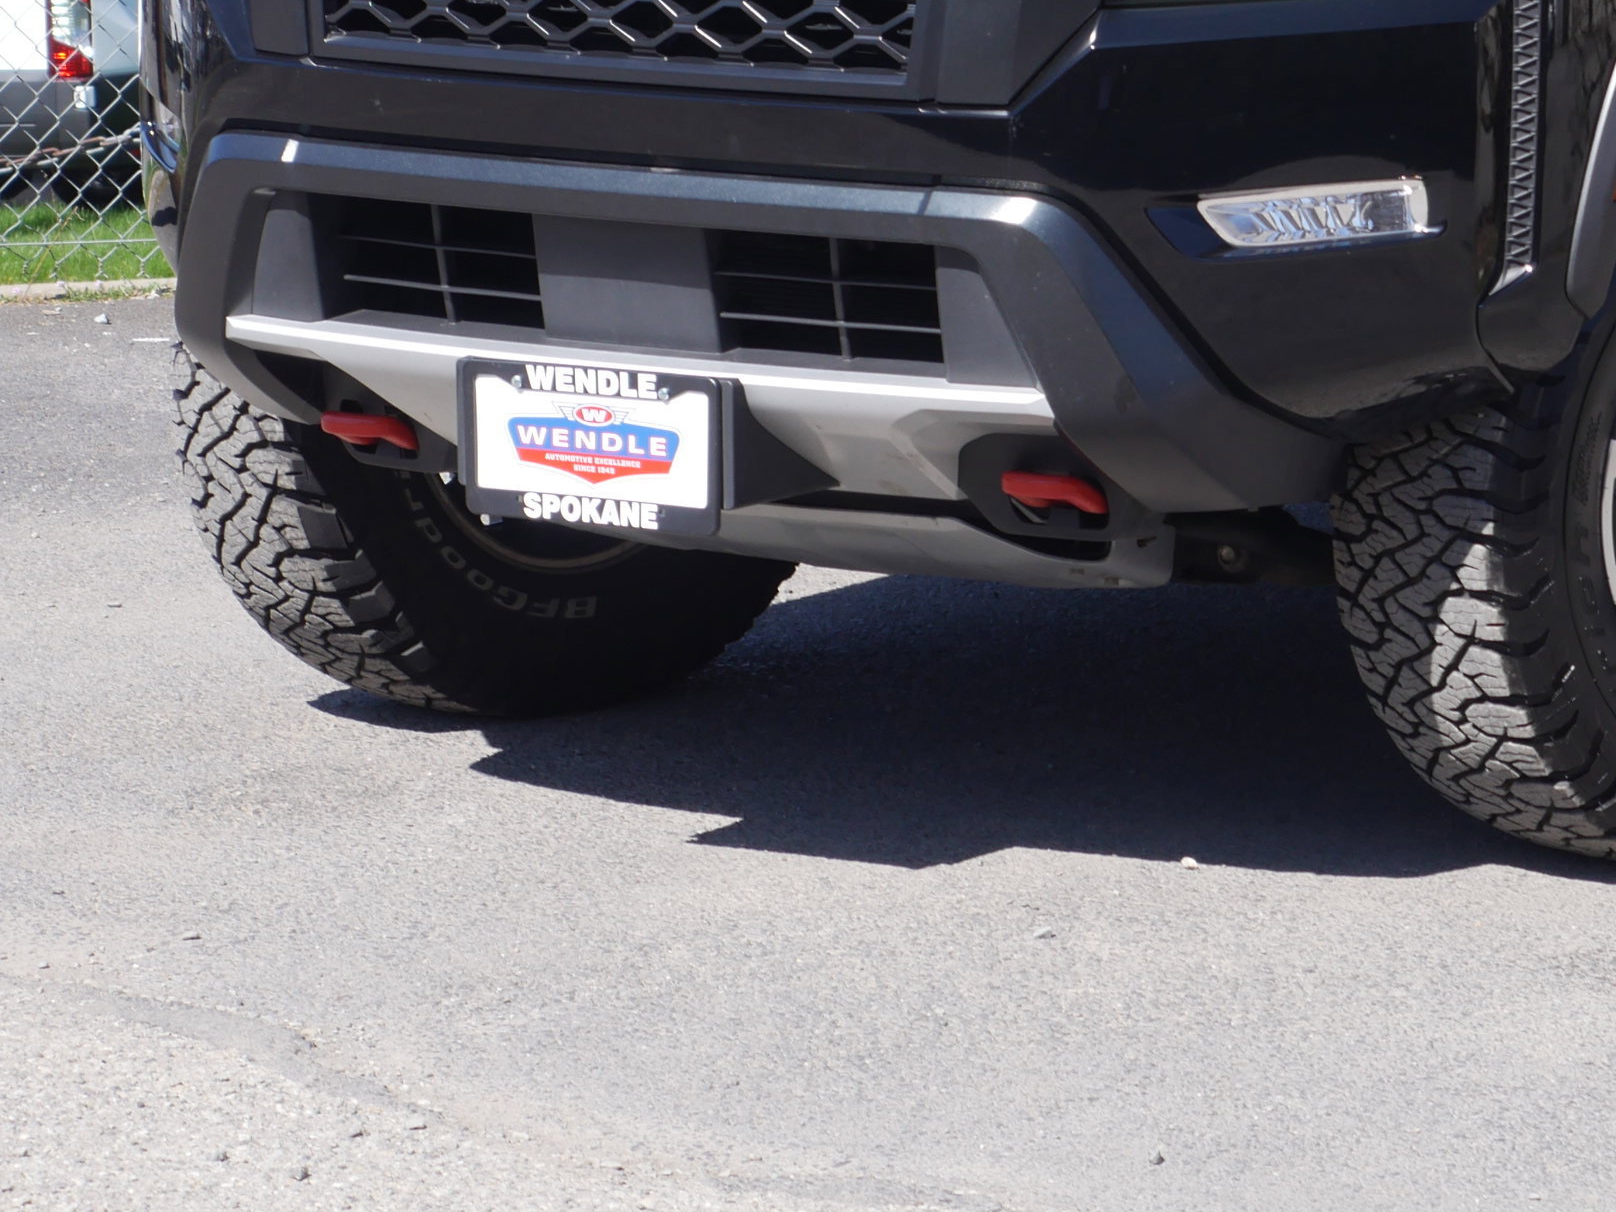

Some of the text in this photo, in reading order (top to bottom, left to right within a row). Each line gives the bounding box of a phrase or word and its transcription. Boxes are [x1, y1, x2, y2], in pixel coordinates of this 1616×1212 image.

[525, 364, 659, 400] WENDLE
[516, 424, 668, 457] WENDLE
[544, 452, 642, 469] AUTOMOTIVE EXCELLENCE
[573, 464, 596, 474] SINCE
[523, 491, 659, 530] SPOKANE
